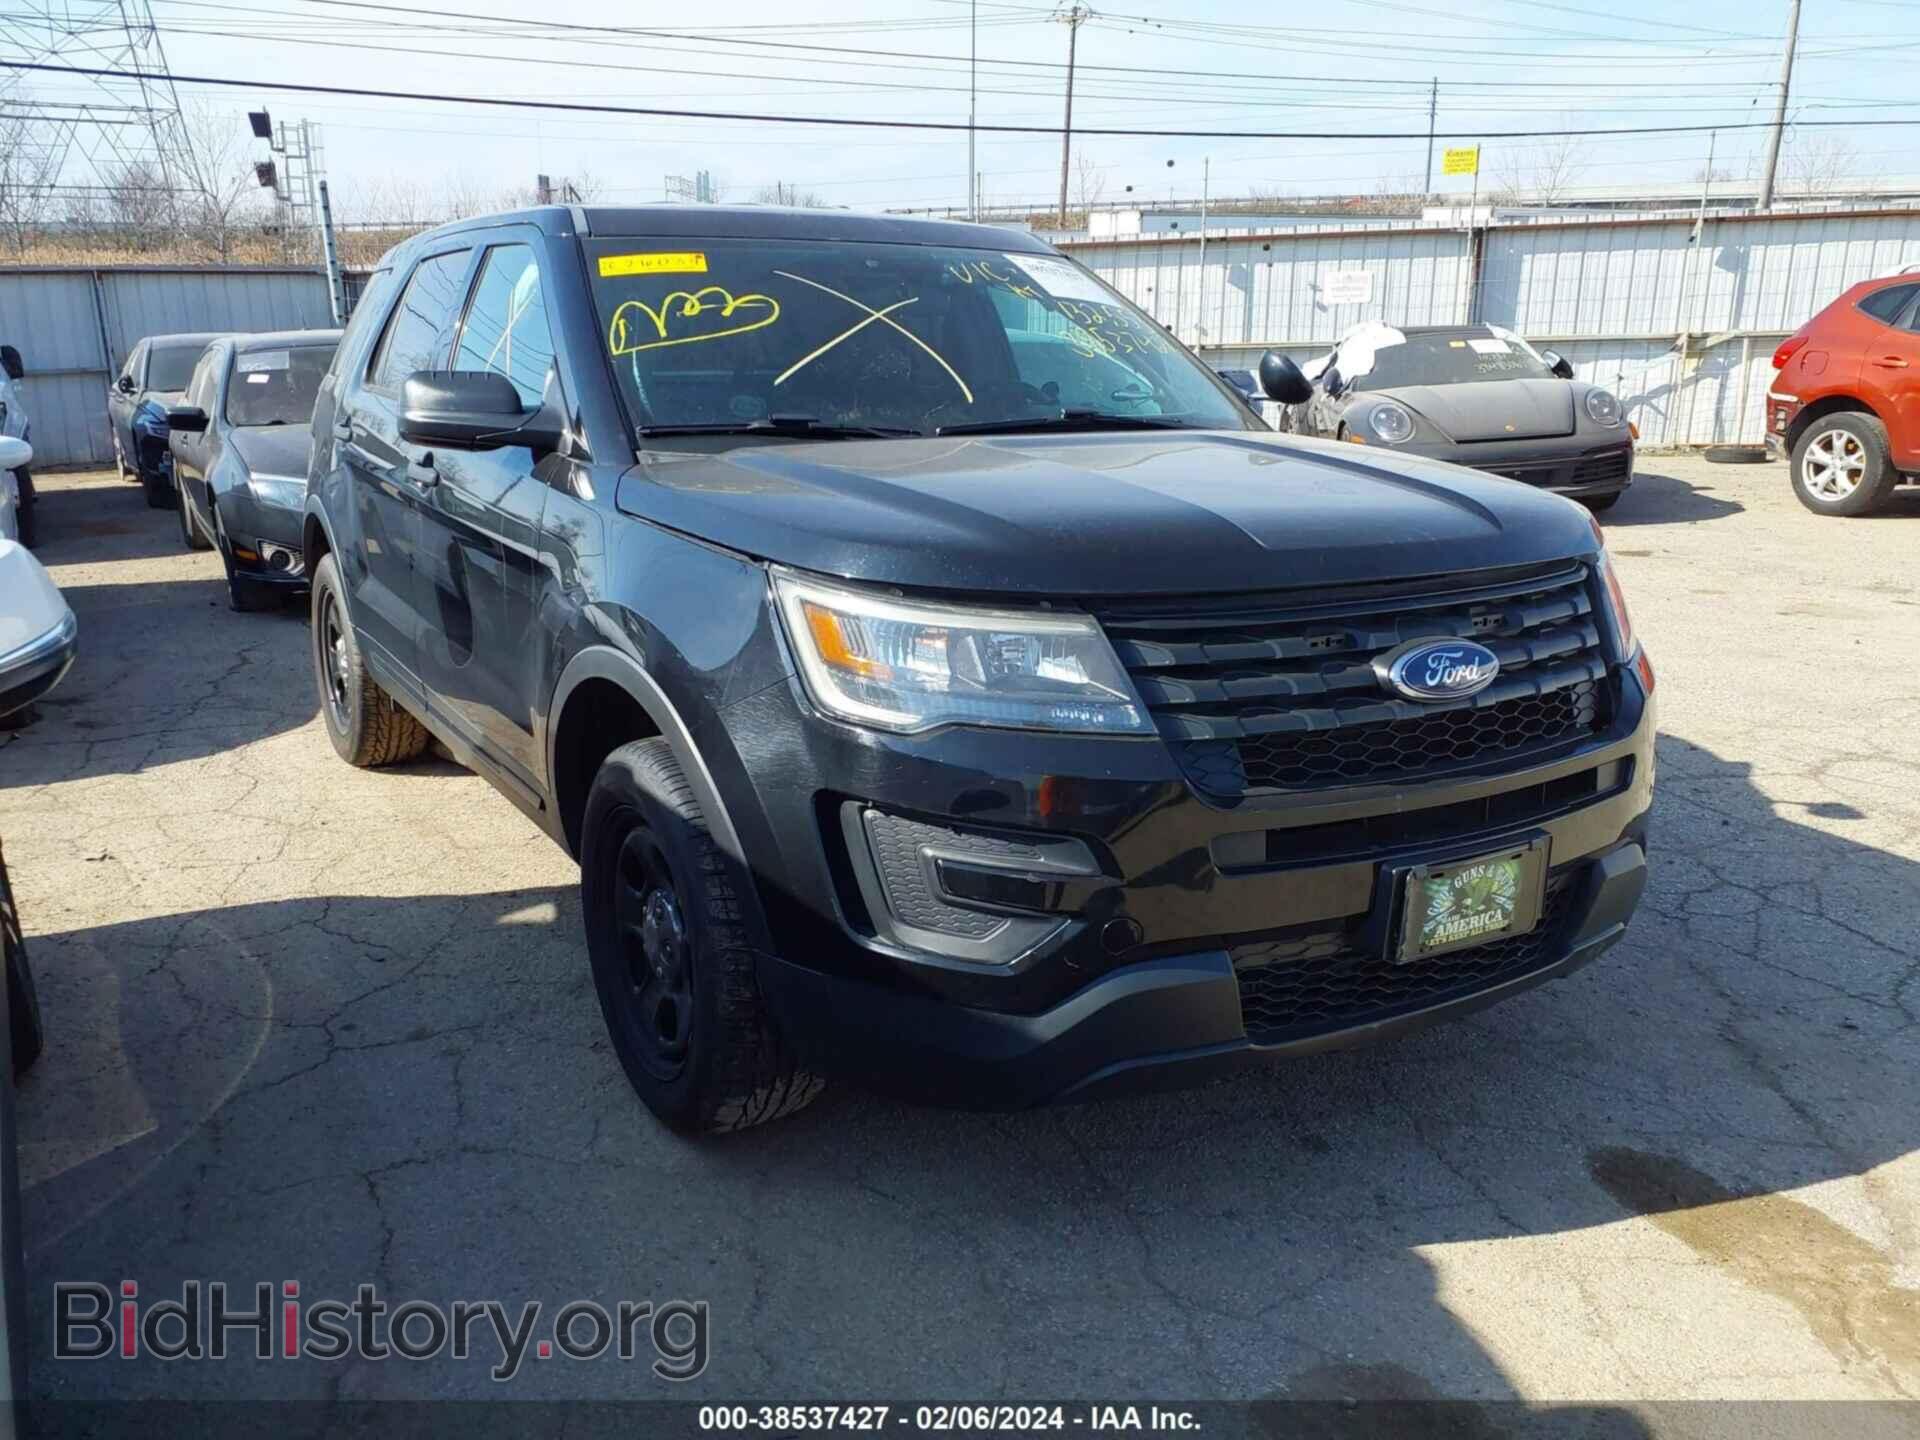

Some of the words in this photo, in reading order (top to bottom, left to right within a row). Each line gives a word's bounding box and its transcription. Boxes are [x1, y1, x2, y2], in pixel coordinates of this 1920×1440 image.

[1424, 650, 1482, 687] Ford
[1454, 864, 1486, 888] GUNS
[1433, 908, 1503, 938] AMERICA
